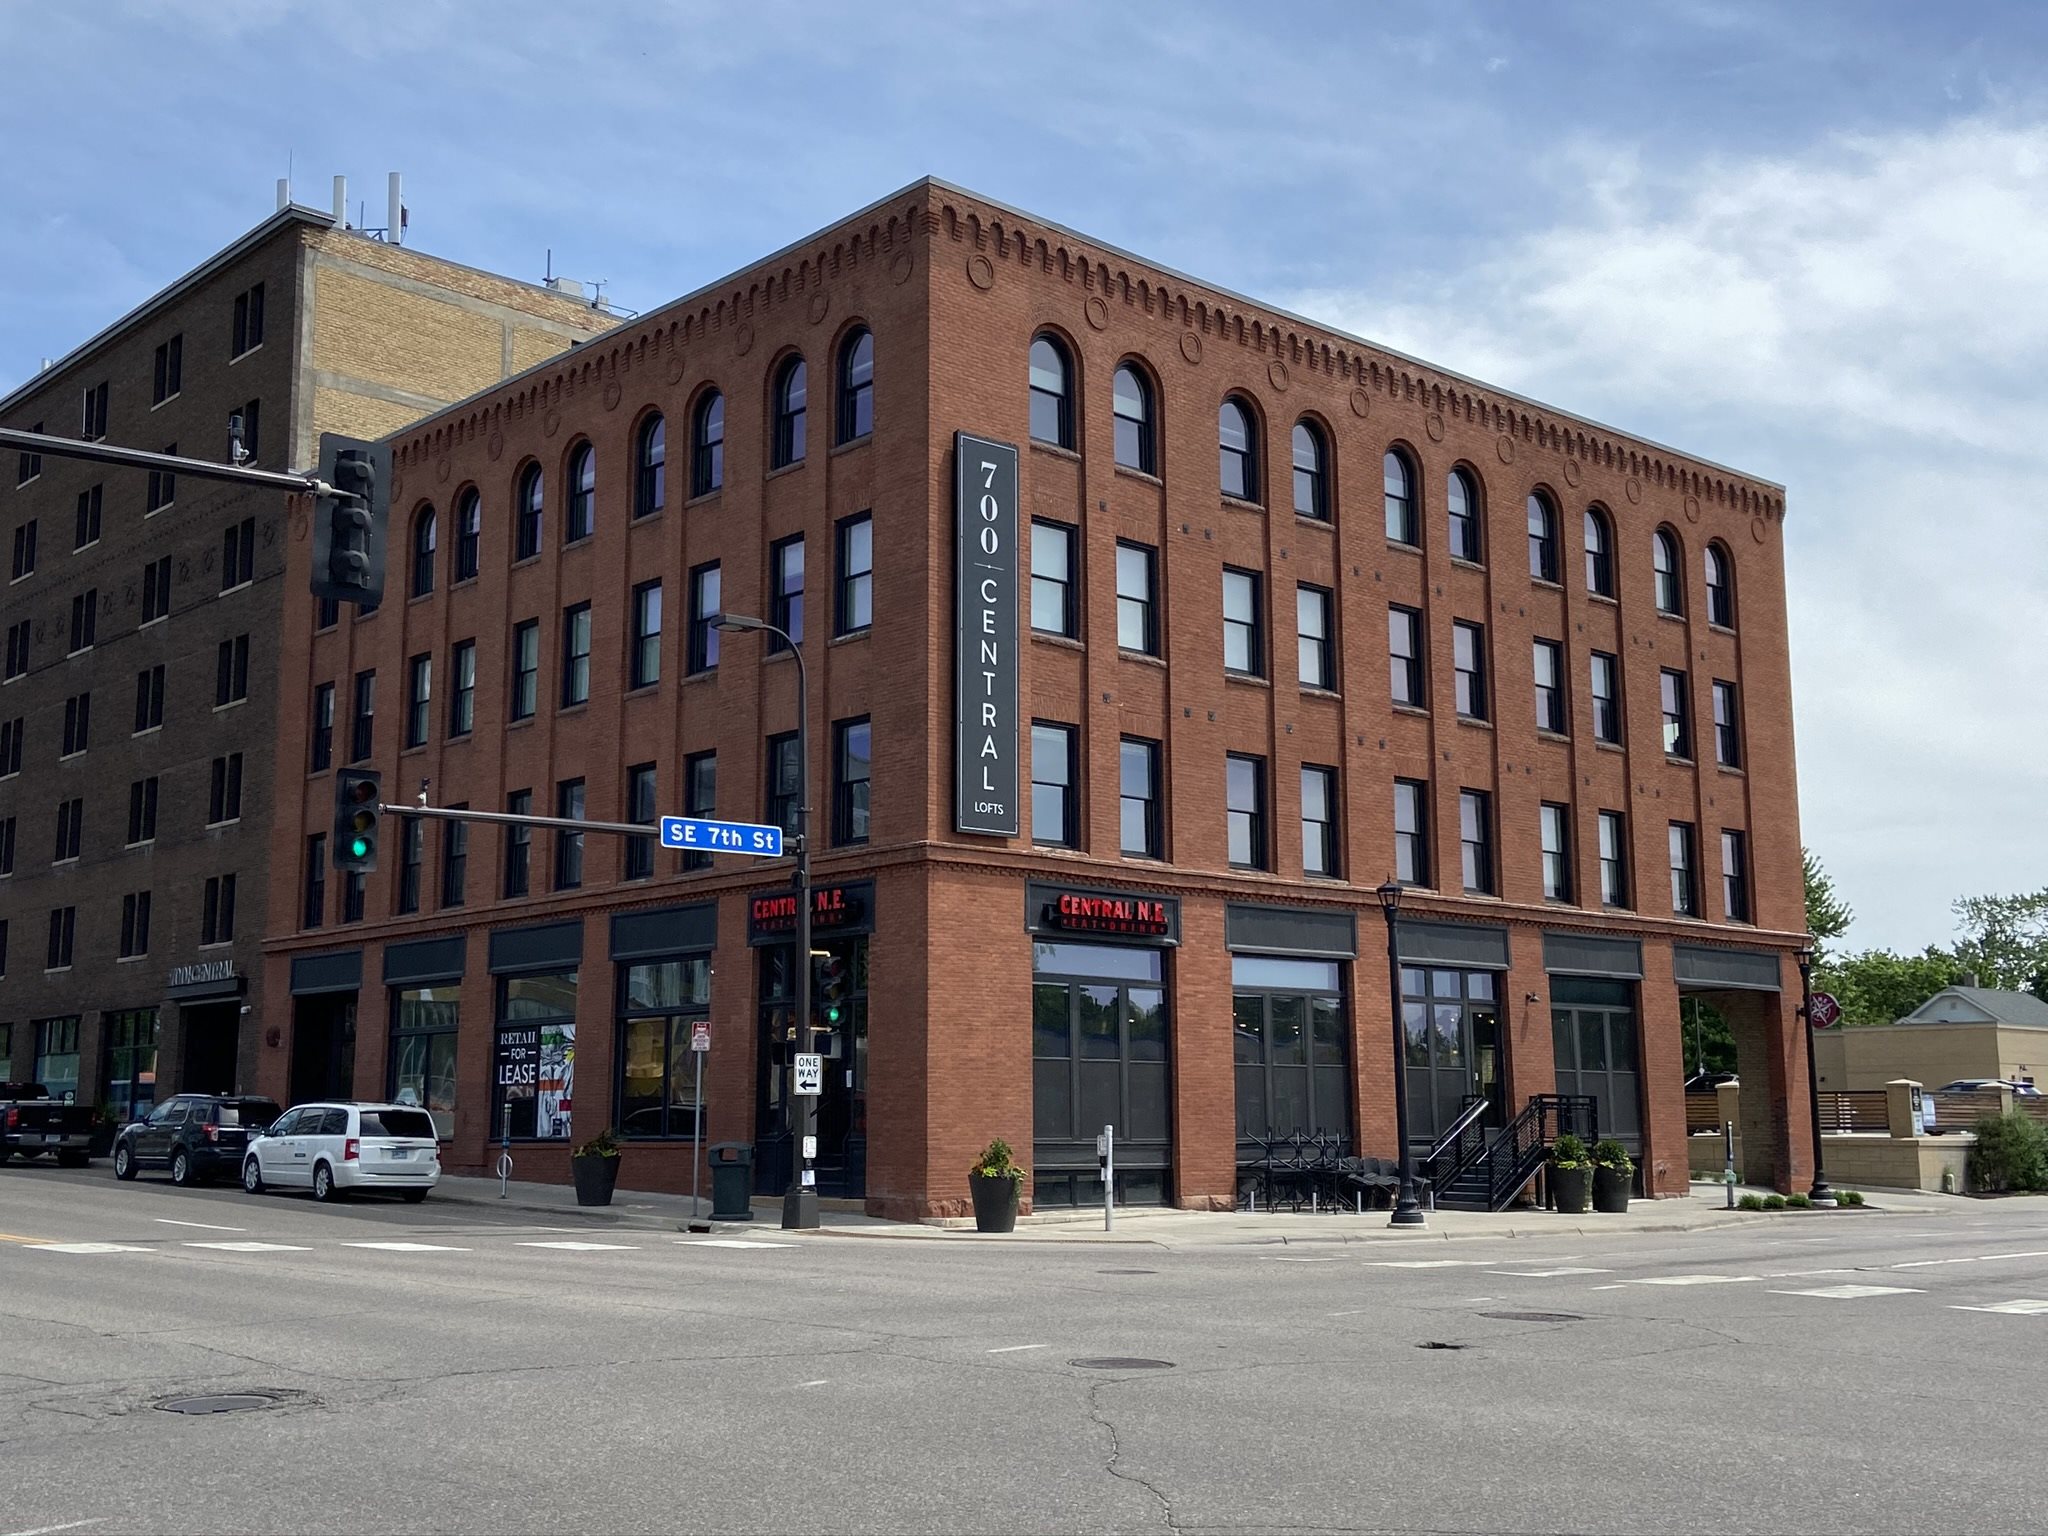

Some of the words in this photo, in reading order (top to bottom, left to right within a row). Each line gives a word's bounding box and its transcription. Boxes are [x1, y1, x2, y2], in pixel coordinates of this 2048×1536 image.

[980, 461, 999, 554] 700
[980, 578, 998, 791] CENTRAL
[974, 801, 1004, 815] LOFTS
[671, 824, 697, 843] SE
[708, 827, 743, 847] 7th
[753, 831, 774, 850] St
[753, 896, 813, 919] CENTR
[1060, 895, 1132, 919] CENTRAL
[1138, 902, 1168, 923] N.E.
[1072, 917, 1097, 929] EAT
[500, 1031, 537, 1045] RETAIL
[511, 1048, 527, 1060] FOR
[798, 1056, 819, 1068] ONE
[499, 1063, 536, 1084] LEASE
[798, 1068, 819, 1079] WAY
